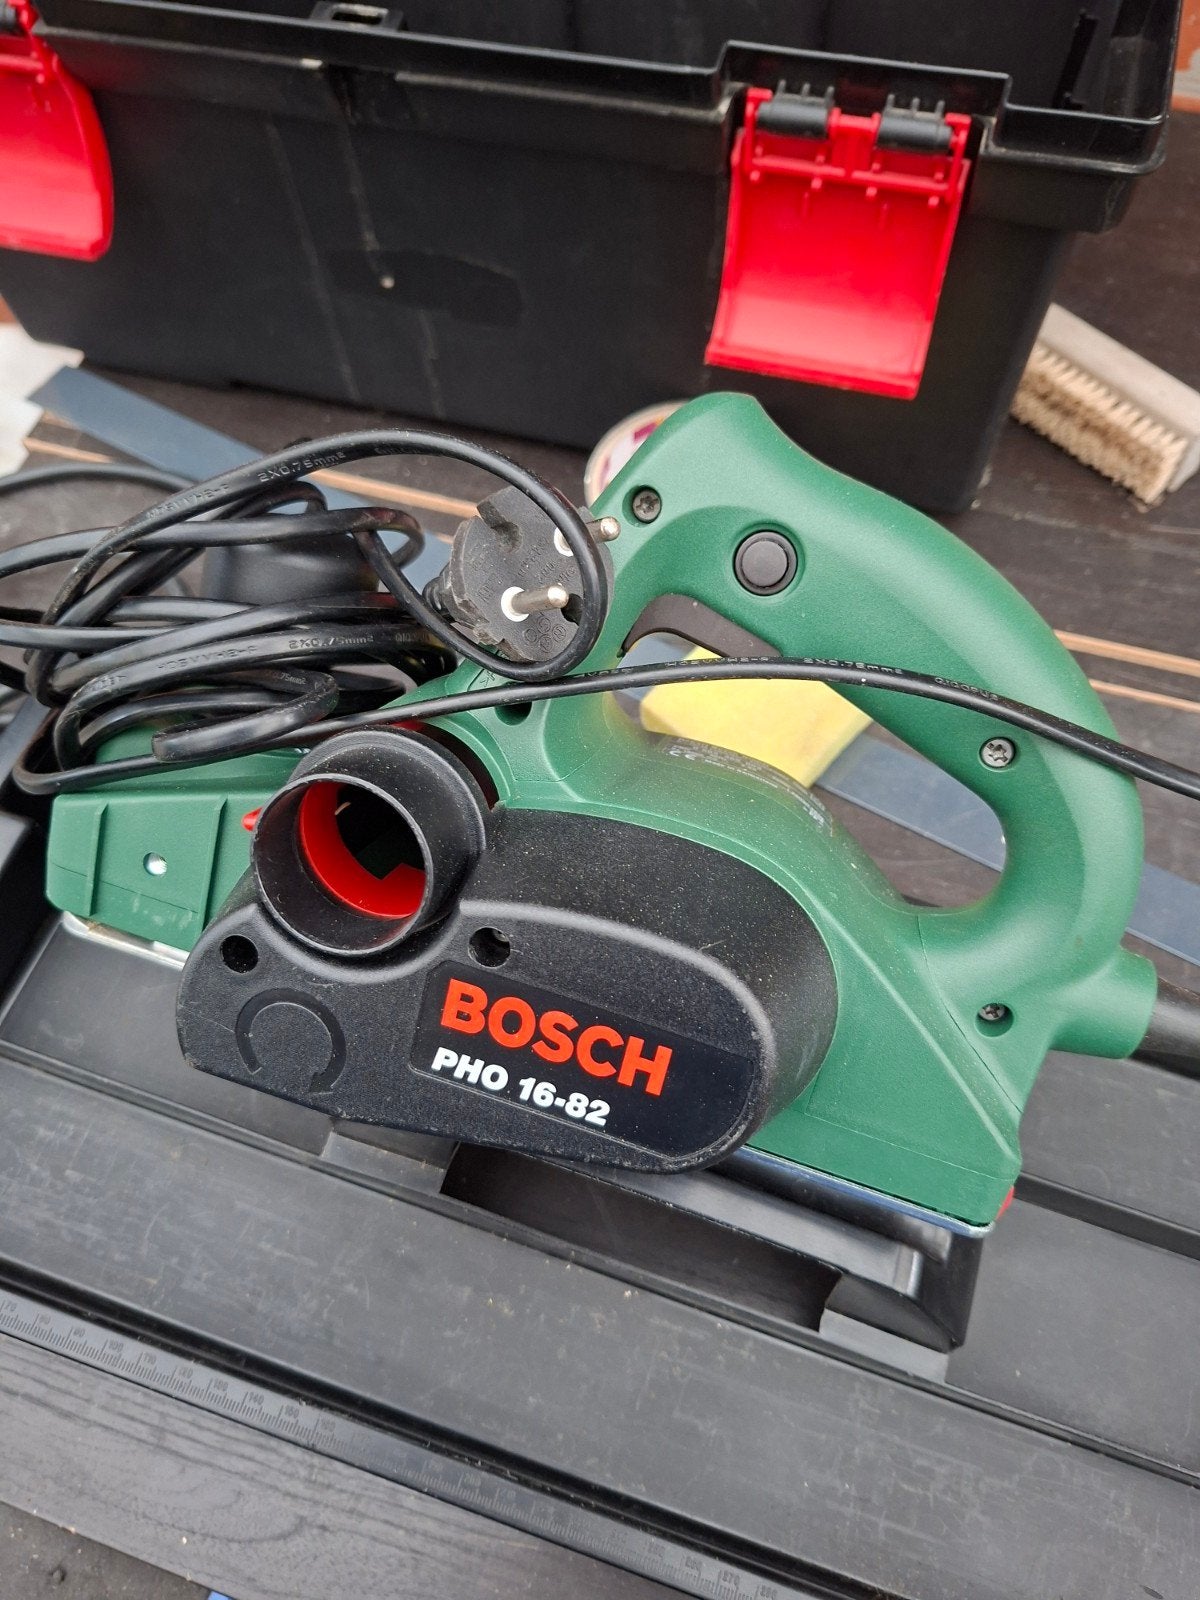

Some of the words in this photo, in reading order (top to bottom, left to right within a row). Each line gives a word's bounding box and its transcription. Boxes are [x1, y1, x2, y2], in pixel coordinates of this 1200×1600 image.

[431, 1046, 508, 1091] PHO
[519, 1077, 612, 1127] 16-82
[440, 978, 673, 1096] BOSCH
